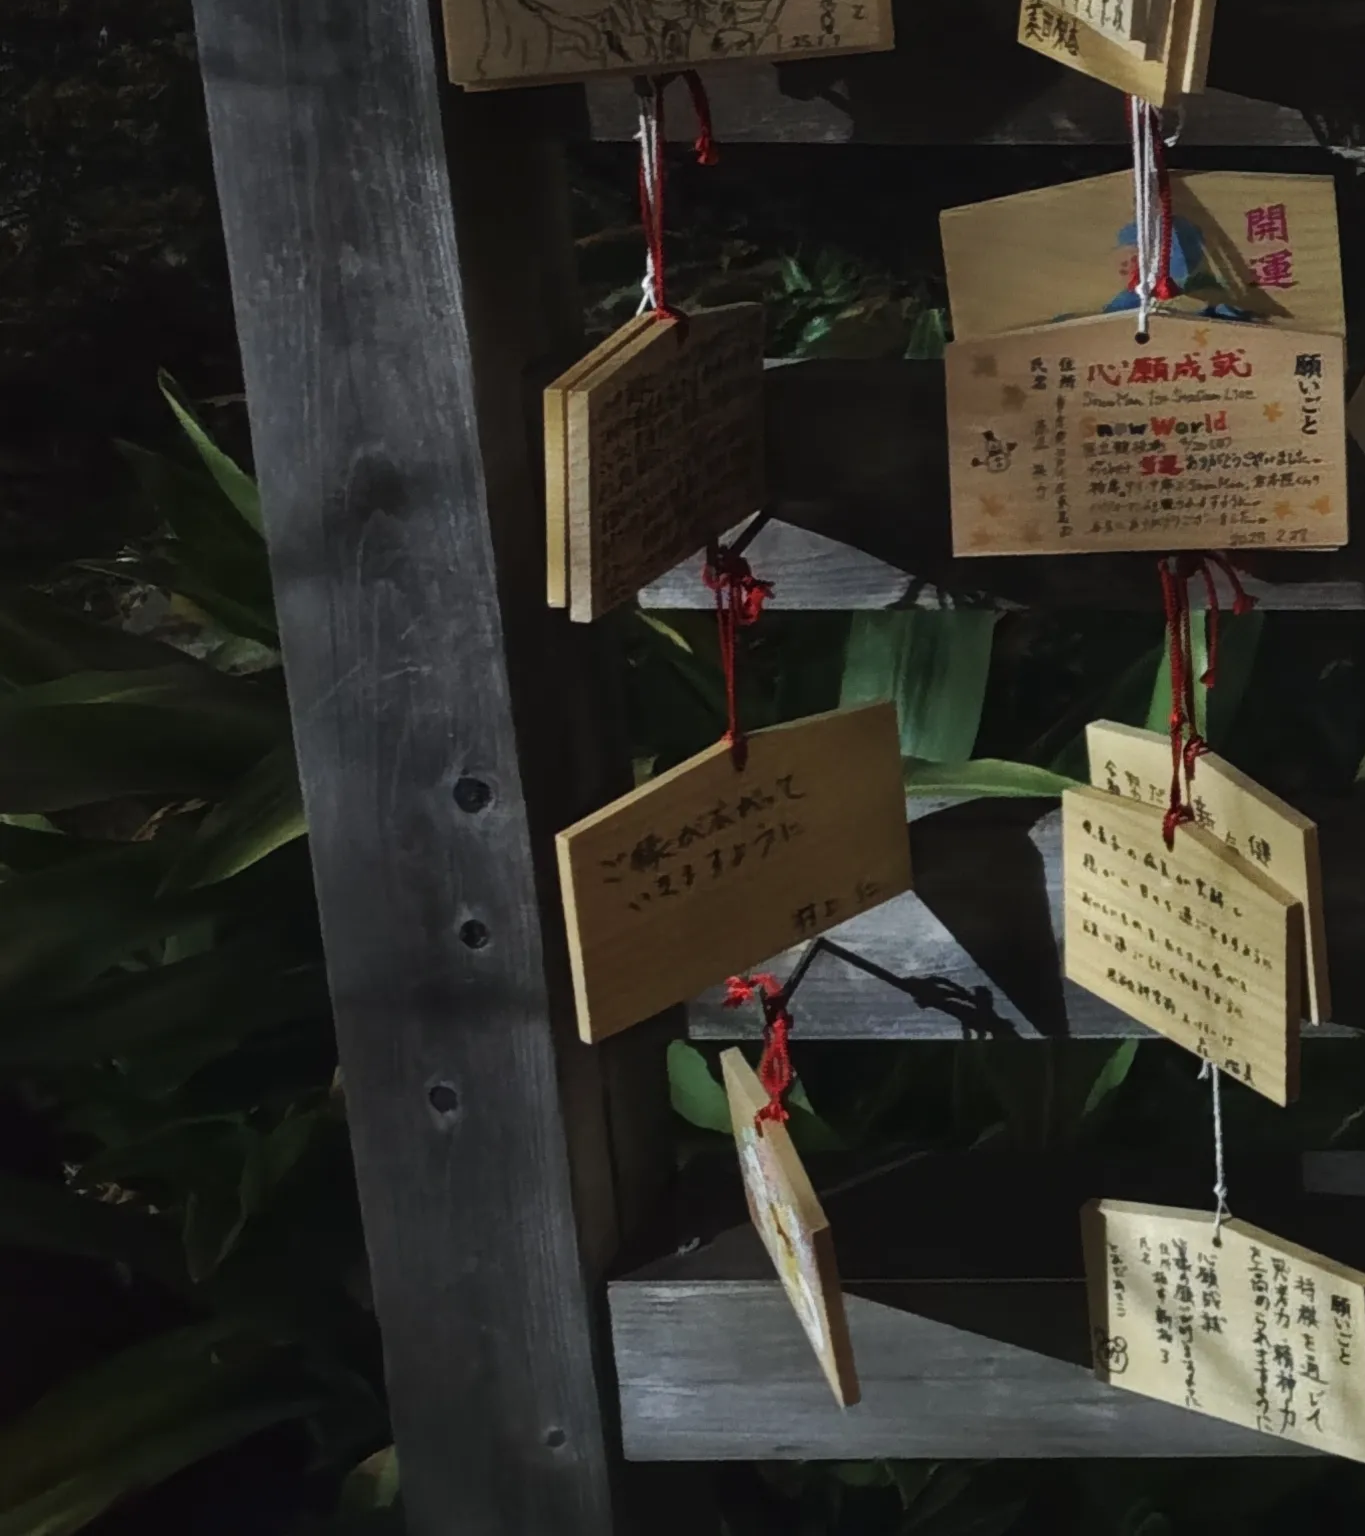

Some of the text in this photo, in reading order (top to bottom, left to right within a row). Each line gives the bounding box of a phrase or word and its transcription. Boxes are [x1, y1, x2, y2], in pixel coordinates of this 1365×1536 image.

[1242, 202, 1298, 290] 開運
[1294, 352, 1322, 436] 願いごと
